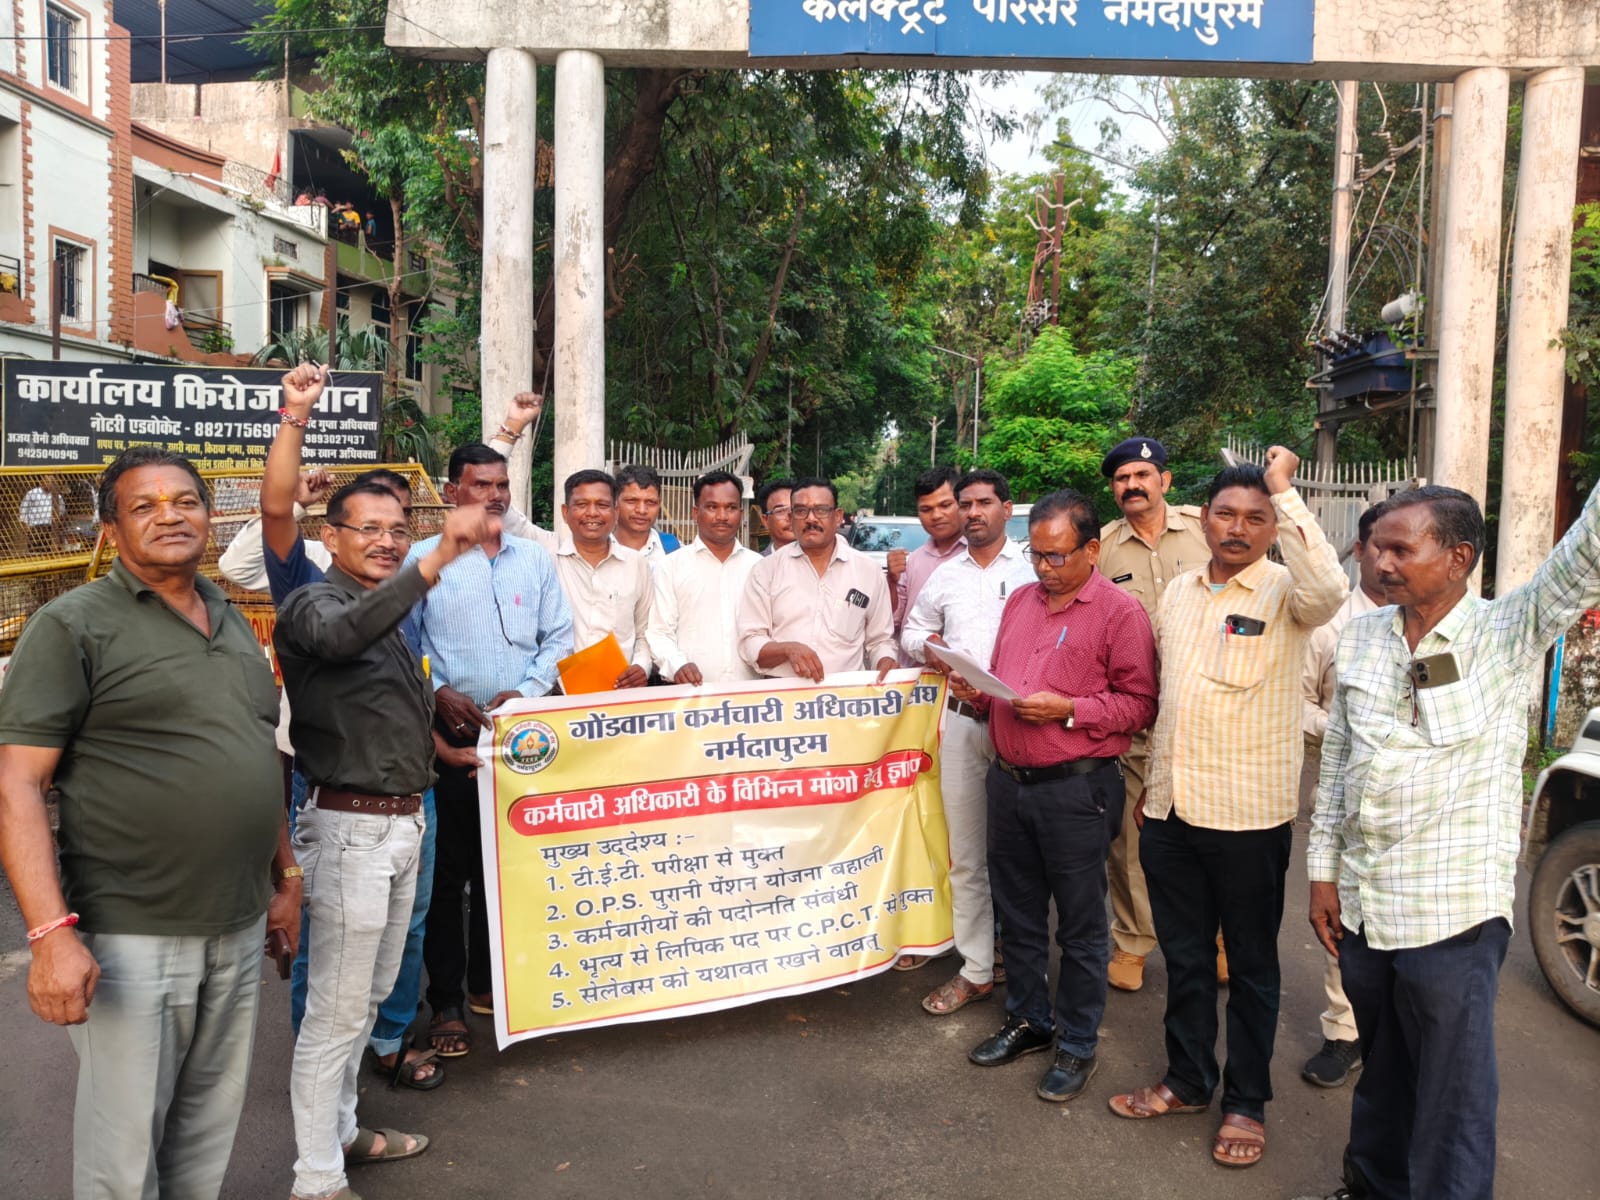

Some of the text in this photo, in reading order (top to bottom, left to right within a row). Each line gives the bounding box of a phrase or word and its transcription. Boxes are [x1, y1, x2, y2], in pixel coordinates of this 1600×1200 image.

[16, 369, 165, 408] कार्यालय
[174, 374, 282, 412] फिरोज
[7, 431, 90, 446] अजय सैनी अधिवक्ता
[90, 412, 126, 433] नोटरी
[129, 415, 182, 436] एडवोकेट
[194, 422, 280, 439] 882775690
[318, 419, 338, 433] गुप्ता
[339, 418, 378, 431] अधिवक्ता
[18, 448, 79, 460] 9425040945
[318, 448, 337, 459] खान
[339, 447, 377, 459] अधिवक्ता
[569, 712, 675, 740] गोंडवाना
[684, 697, 783, 728] कर्मचारी
[793, 690, 904, 720] अधिकारी
[704, 732, 829, 762] नर्मदापुरम
[523, 793, 605, 826] कर्मचारी
[613, 782, 700, 816] अधिकारी
[706, 780, 726, 804] के
[732, 774, 803, 802] विभिन्न
[809, 770, 859, 796] मांगो
[887, 757, 922, 785] ज्ञाप
[540, 842, 590, 868] मुख्य
[546, 846, 785, 892] 1. टी.ई.टी. परीक्षा से मुक्त
[547, 845, 884, 921] 2. O.P.S. पुरानी पेंशन योजना बहाली
[548, 881, 858, 950] 3. कर्मचारीयों की पदोन्नति संबंधी
[549, 962, 570, 978] 4.
[580, 953, 623, 979] भृत्य
[630, 944, 649, 965] से
[656, 936, 724, 961] लिपिक
[730, 931, 759, 949] पद
[765, 926, 792, 943] पर
[797, 905, 879, 938] C.P.C.T.
[552, 991, 572, 1009] 5.
[579, 977, 655, 1003] सेलेबस
[660, 966, 690, 989] को
[695, 958, 768, 983] यथावत
[773, 944, 820, 969] रखने
